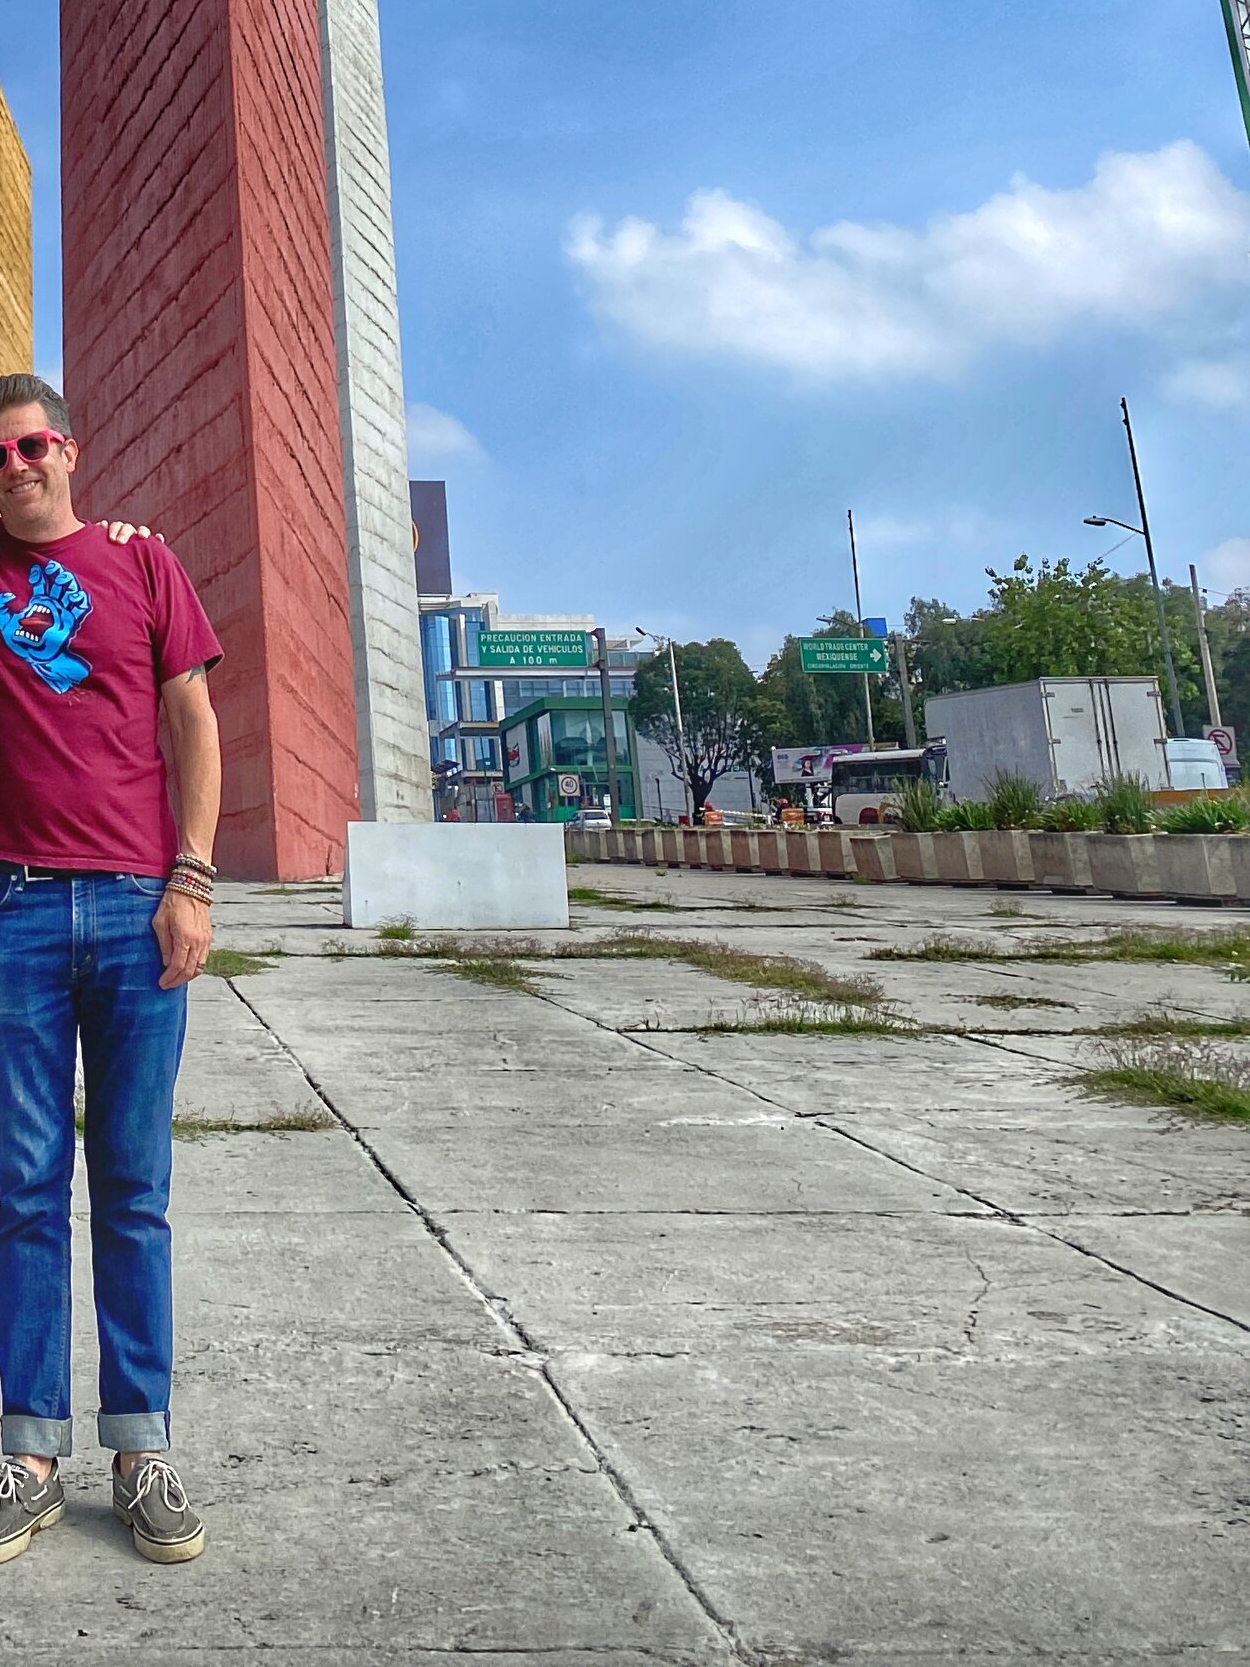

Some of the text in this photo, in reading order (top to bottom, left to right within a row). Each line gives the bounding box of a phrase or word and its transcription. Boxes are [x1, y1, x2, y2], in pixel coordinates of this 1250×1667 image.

[480, 634, 582, 642] PRECAUCION ENTRADA
[481, 645, 583, 653] Y SALIDA DE VEHICULOS
[803, 643, 868, 651] WORLD TRADE CENTER
[510, 656, 516, 664] A
[523, 656, 542, 664] 100
[816, 653, 858, 661] MEXIQUENSE
